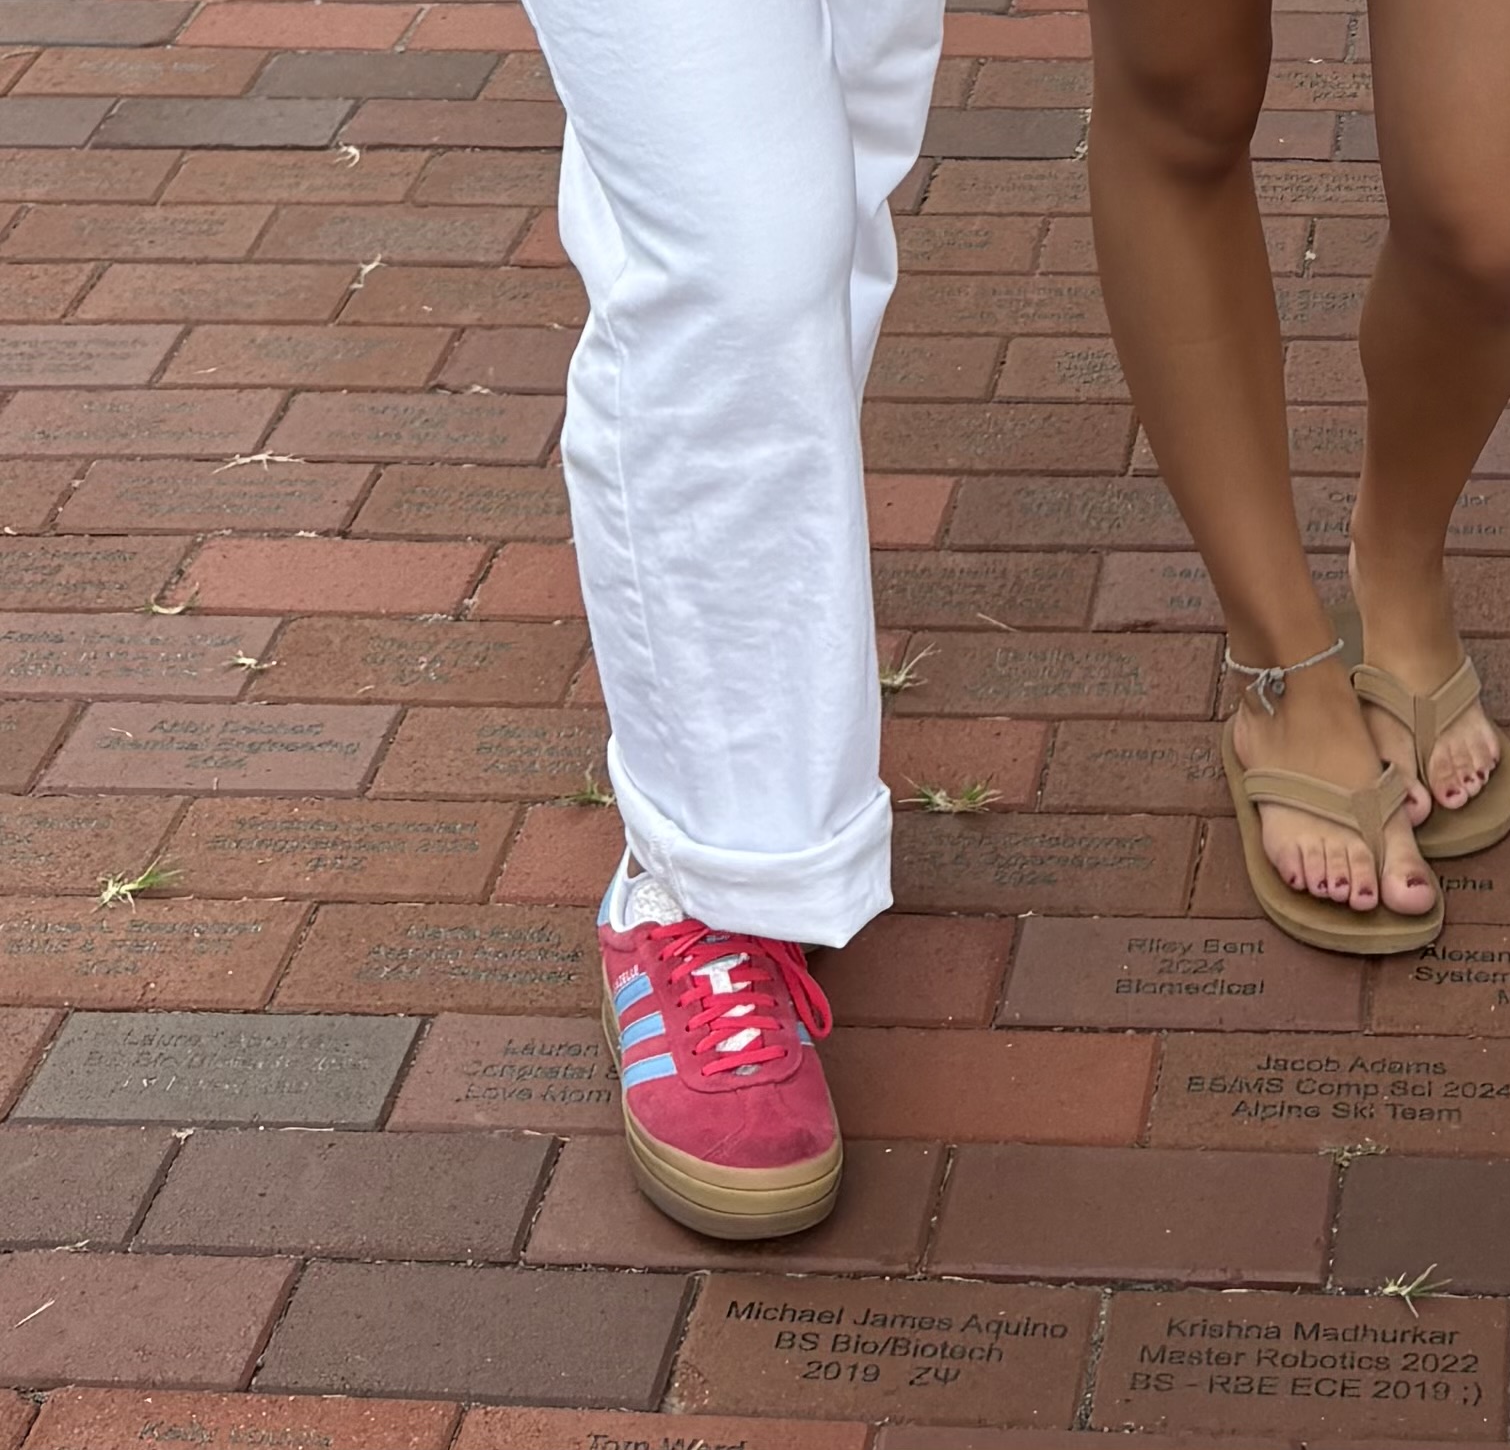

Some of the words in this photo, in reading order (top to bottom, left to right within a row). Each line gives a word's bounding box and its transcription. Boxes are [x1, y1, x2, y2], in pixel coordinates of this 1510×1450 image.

[1440, 874, 1494, 893] lpha
[1115, 978, 1265, 996] Biomedical
[1257, 1053, 1341, 1074] Jacob
[1349, 1055, 1447, 1076] Adams
[1296, 1078, 1380, 1103] Comp
[1390, 1080, 1433, 1099] Sci
[1231, 1100, 1321, 1123] Alpine
[1332, 1102, 1376, 1121] Ski
[1385, 1103, 1463, 1123] Team
[726, 1300, 843, 1326] Michael
[853, 1307, 953, 1332] James
[960, 1313, 1069, 1343] Aquino
[1166, 1317, 1282, 1341] Krishna
[1293, 1321, 1460, 1346] Madhurkar
[774, 1330, 820, 1352] BS
[831, 1334, 1005, 1363] Bio/Biotech
[1139, 1344, 1244, 1367] Master
[1256, 1348, 1391, 1372] Robotics
[1402, 1352, 1480, 1374] 2022
[802, 1360, 881, 1384] 2019
[1129, 1372, 1175, 1392] BS
[1208, 1374, 1280, 1396] RBE
[1290, 1376, 1362, 1398] ECE
[1373, 1379, 1452, 1401] 2019
